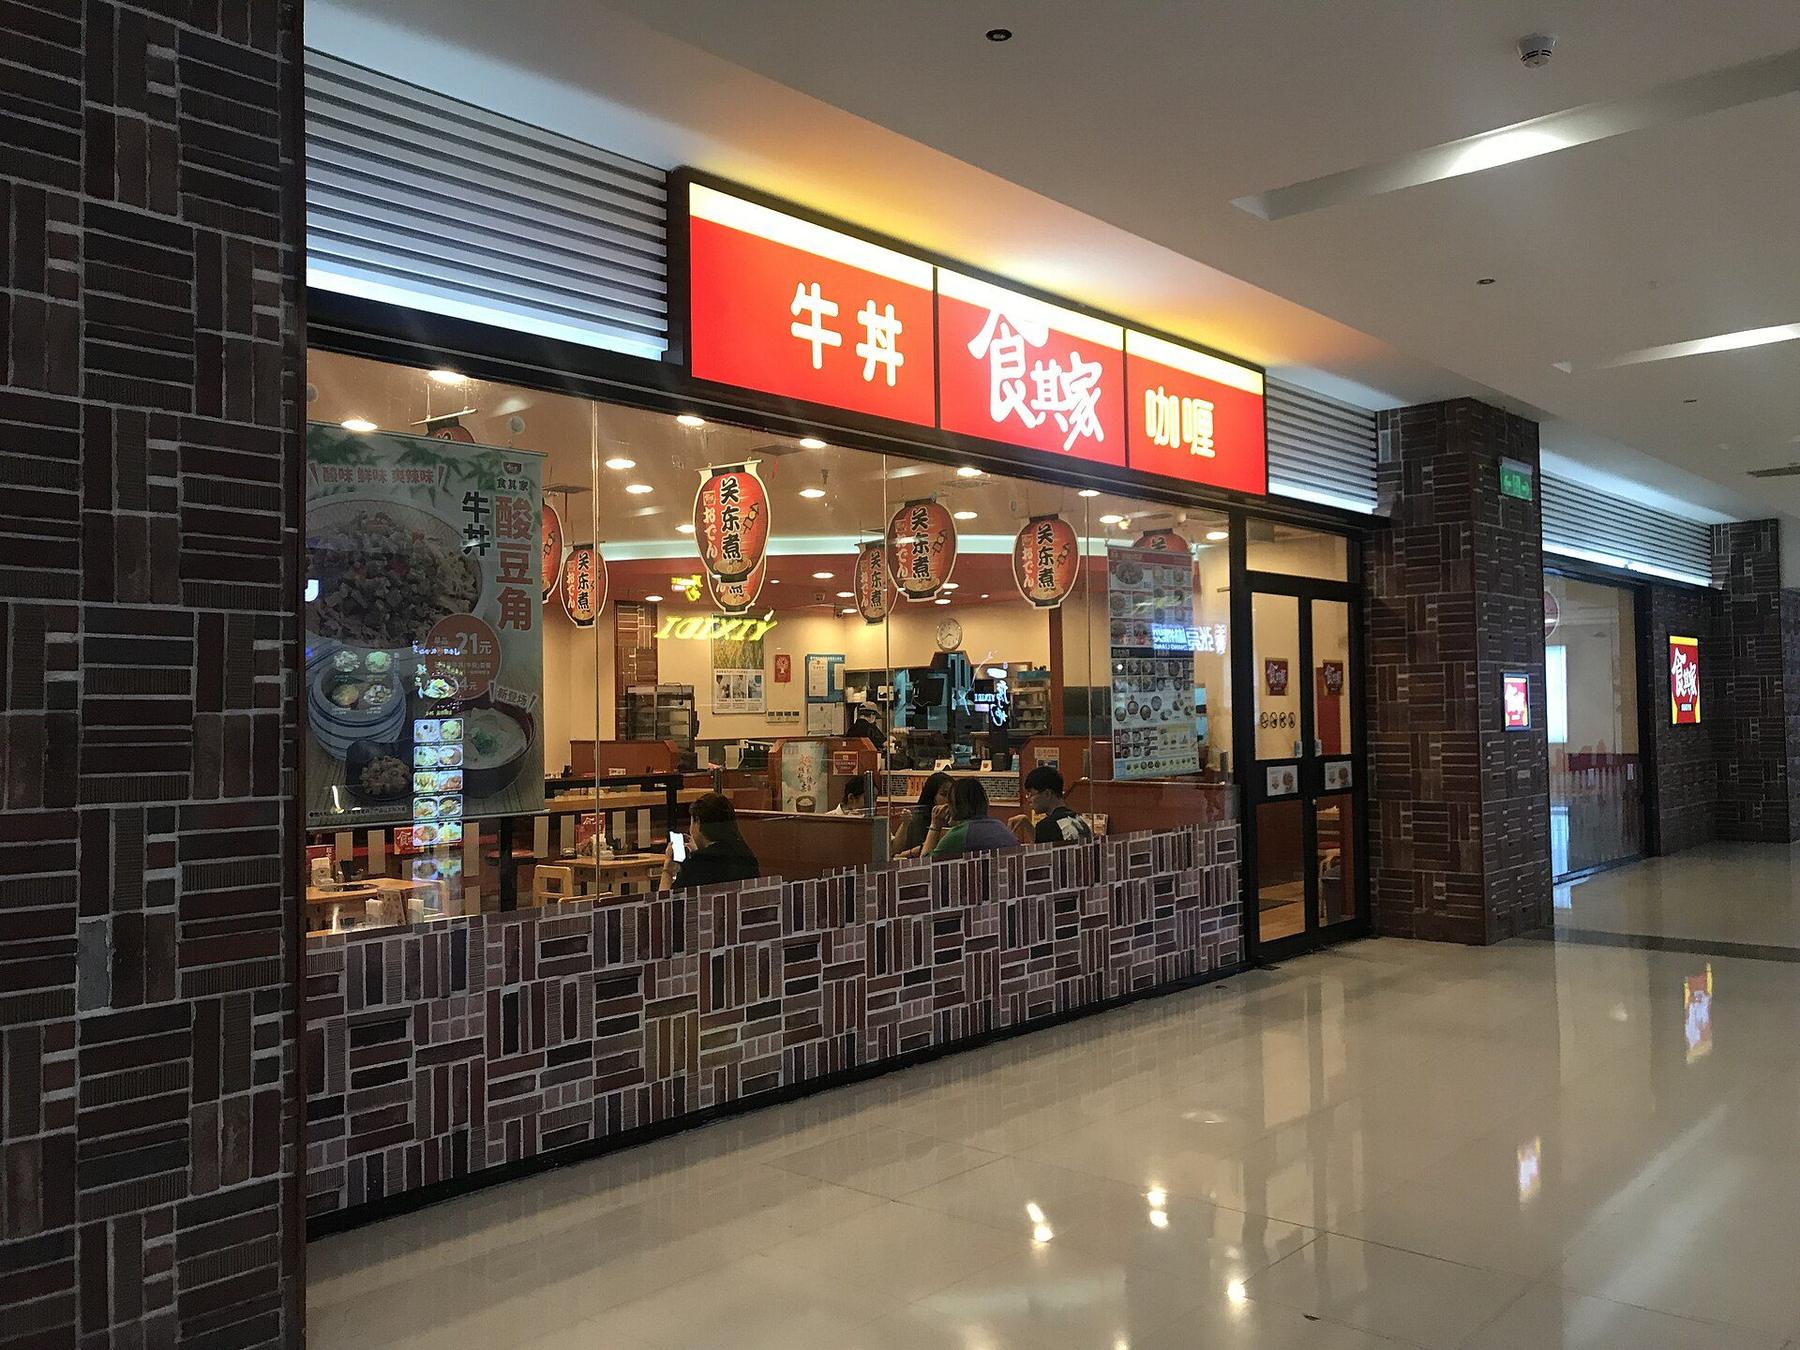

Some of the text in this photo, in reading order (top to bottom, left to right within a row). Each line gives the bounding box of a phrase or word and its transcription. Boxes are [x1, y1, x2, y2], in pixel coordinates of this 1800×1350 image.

[790, 282, 904, 387] 牛丼
[967, 308, 1104, 451] 食其家
[1145, 385, 1215, 459] 咖喱
[497, 477, 529, 491] 食其家
[462, 491, 491, 556] 牛丼
[703, 506, 718, 560] おでん
[720, 476, 741, 560] 关东煮
[911, 507, 930, 579] 关东煮
[495, 495, 533, 631] 酸豆角
[577, 553, 591, 611] 关东煮
[869, 551, 882, 609] 关东煮
[1021, 549, 1035, 589] おでん
[1037, 523, 1055, 590] 关东煮
[566, 573, 575, 609] おでん
